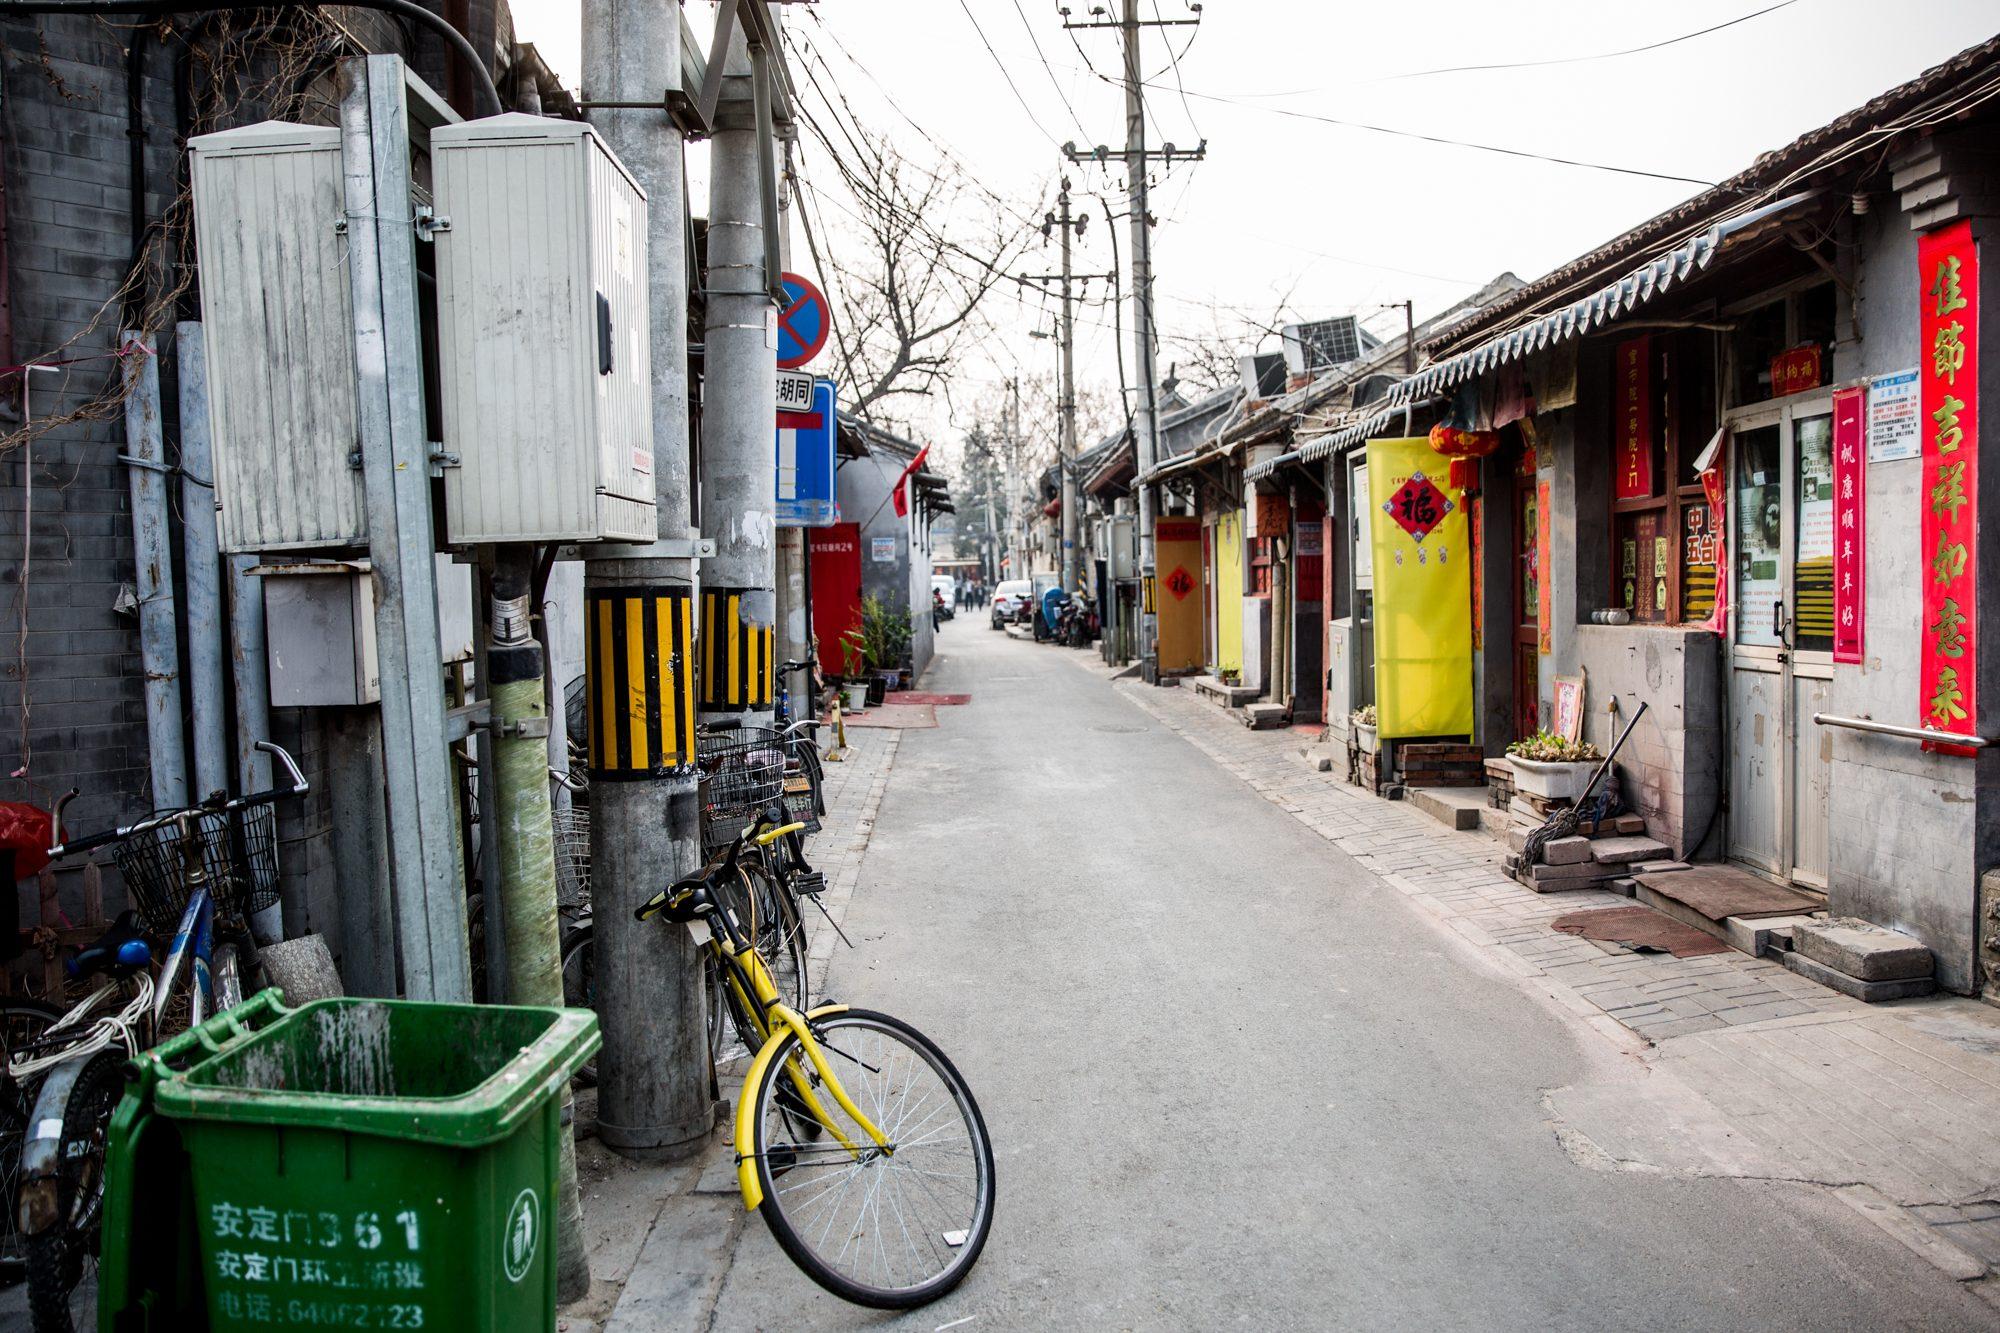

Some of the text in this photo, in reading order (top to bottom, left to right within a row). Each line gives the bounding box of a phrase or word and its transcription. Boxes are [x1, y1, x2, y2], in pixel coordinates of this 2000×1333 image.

[776, 378, 810, 404] 胡同
[1401, 487, 1437, 525] 福
[1687, 534, 1717, 565] 五台
